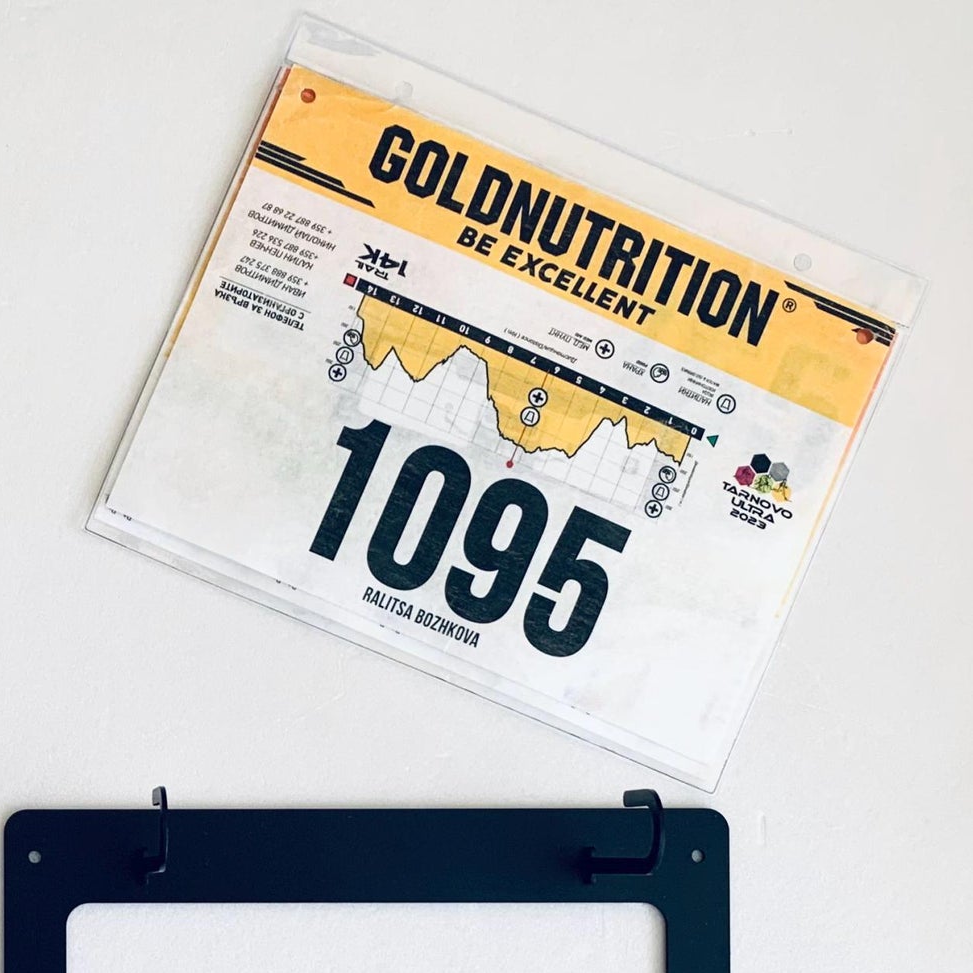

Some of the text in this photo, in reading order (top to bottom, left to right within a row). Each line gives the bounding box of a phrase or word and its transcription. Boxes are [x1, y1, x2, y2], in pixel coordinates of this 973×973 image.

[261, 202, 274, 212] 87
[272, 206, 285, 216] 68
[283, 210, 296, 221] 22
[247, 209, 337, 252] НИКОЛАЙ ДИМИТРОВ
[294, 216, 312, 227] 887
[310, 222, 327, 234] 359
[252, 228, 268, 241] 226
[267, 234, 284, 248] 536
[239, 255, 257, 267] 247
[248, 239, 314, 271] КАЛИН ПЕНЧЕВ
[358, 243, 408, 277] 14K
[255, 260, 272, 273] 375
[270, 267, 288, 279] 888
[355, 260, 389, 280] TRAIL
[457, 226, 656, 326] BE EXCELLENT
[234, 264, 307, 298] ИВАН ДИМИТРОВ
[286, 274, 304, 286] 359
[214, 288, 305, 331] ТЕЛЕФОН ЗА ВРЪЗКА
[219, 280, 305, 320] С ОРГАНИЗАТОРИТЕ
[722, 480, 793, 520] TARNOVO
[731, 496, 775, 524] ULTRA
[729, 508, 767, 530] 2023
[309, 419, 633, 657] 1095
[362, 586, 481, 648] RALITSA BOZHKOVA
